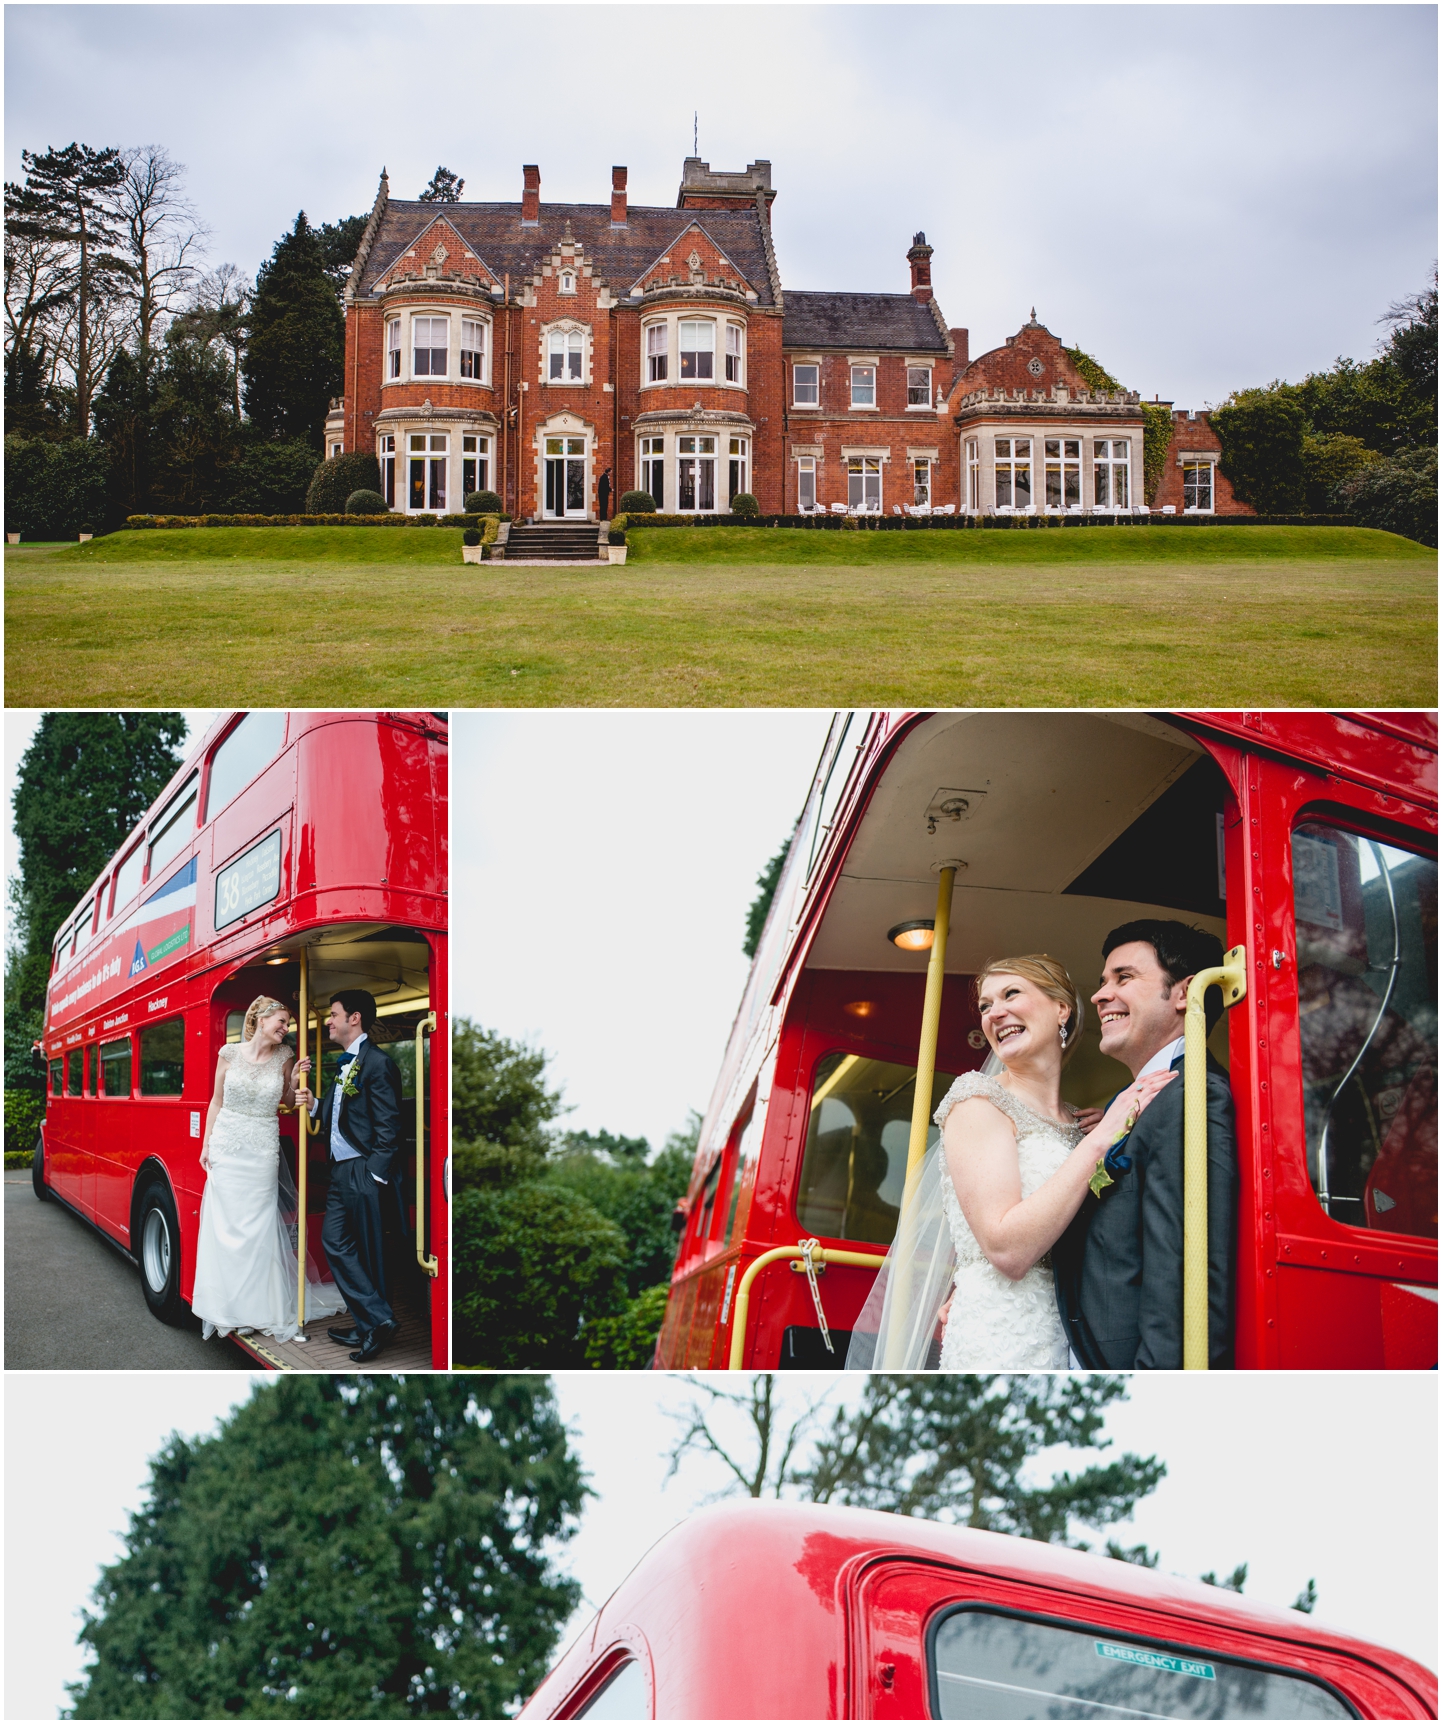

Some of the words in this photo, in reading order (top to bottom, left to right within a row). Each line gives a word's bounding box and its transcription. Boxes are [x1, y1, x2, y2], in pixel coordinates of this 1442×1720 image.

[220, 872, 240, 915] 38
[148, 997, 168, 1012] Hackney
[1102, 1645, 1177, 1670] EMERGENCY
[1180, 1661, 1206, 1676] EXIT
